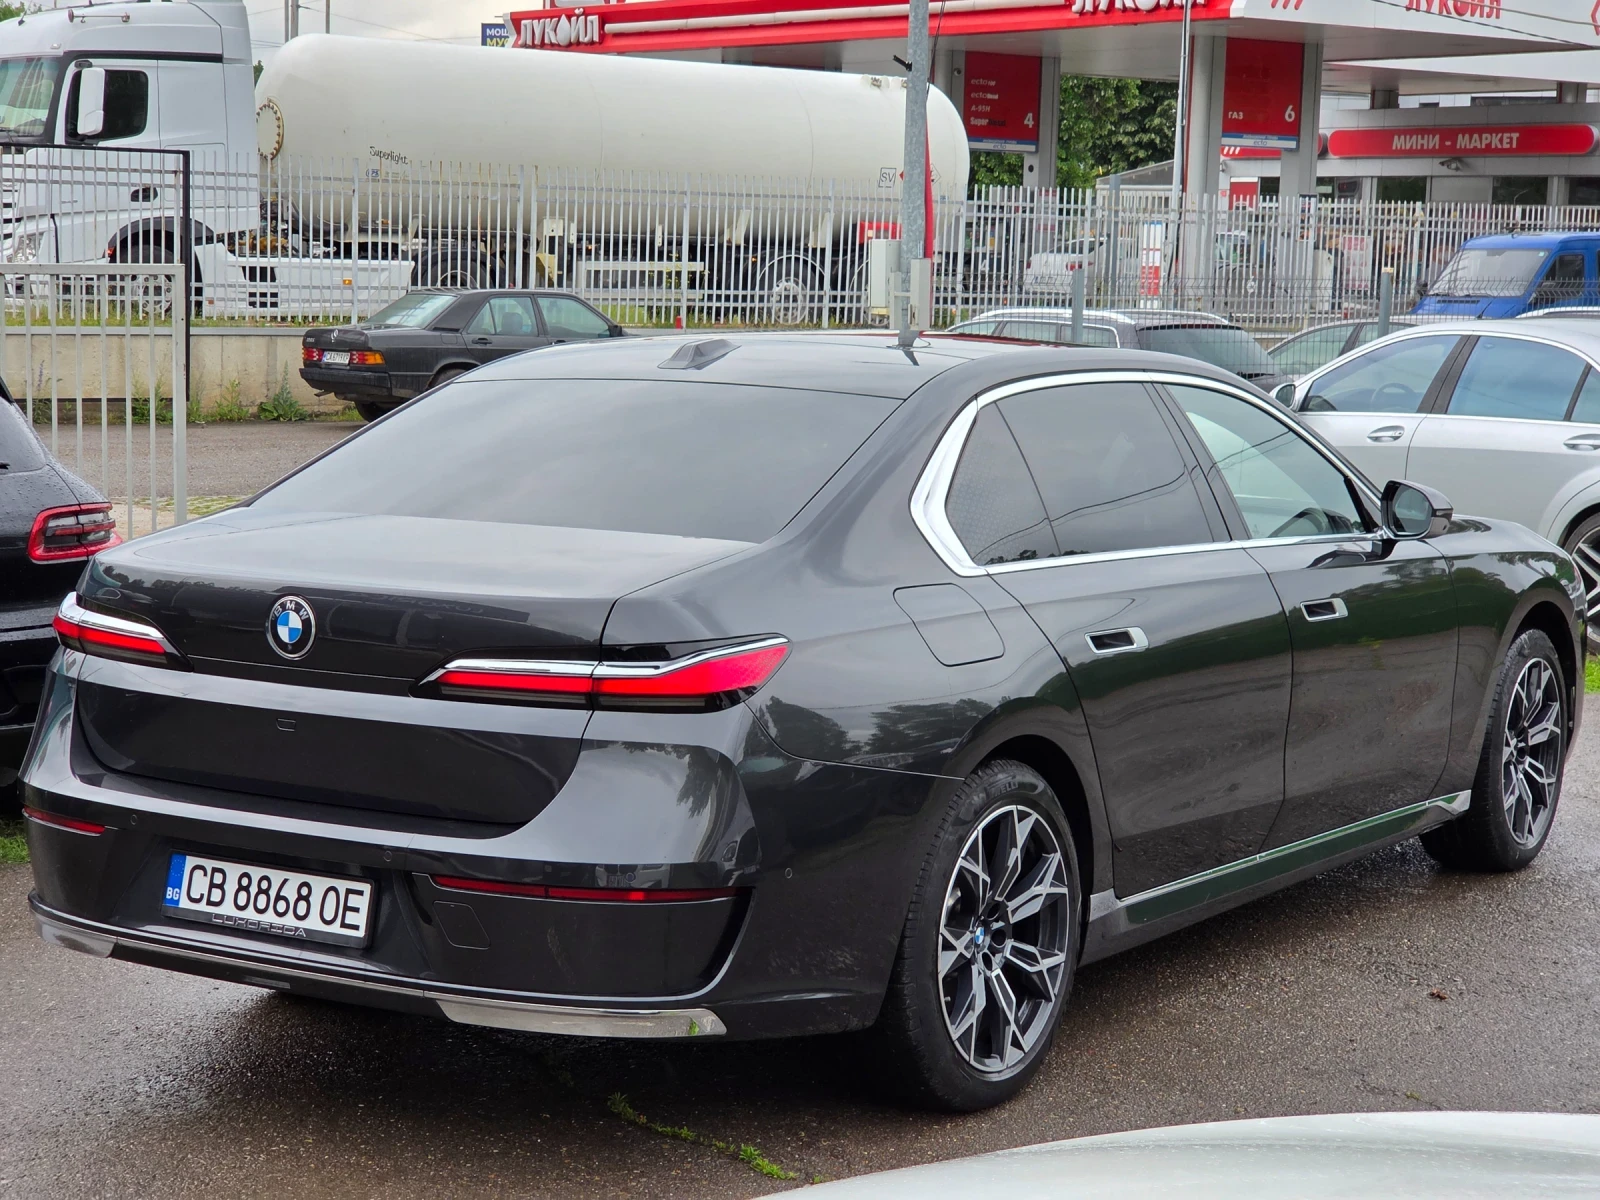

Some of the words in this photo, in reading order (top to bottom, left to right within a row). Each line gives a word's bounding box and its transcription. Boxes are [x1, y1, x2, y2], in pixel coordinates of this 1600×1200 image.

[518, 7, 599, 46] ЛУКОЙЛ
[1023, 112, 1035, 129] 4
[1228, 111, 1244, 120] ГАЗ
[1284, 104, 1295, 122] 6
[1392, 134, 1440, 150] МИНИ
[1456, 132, 1520, 149] МАРКЕТ
[369, 146, 409, 165] Superlight
[880, 172, 895, 183] SV
[273, 600, 310, 620] BMW
[166, 886, 180, 901] BG
[186, 864, 228, 907] CB
[232, 871, 313, 921] 8868
[318, 885, 365, 931] OE
